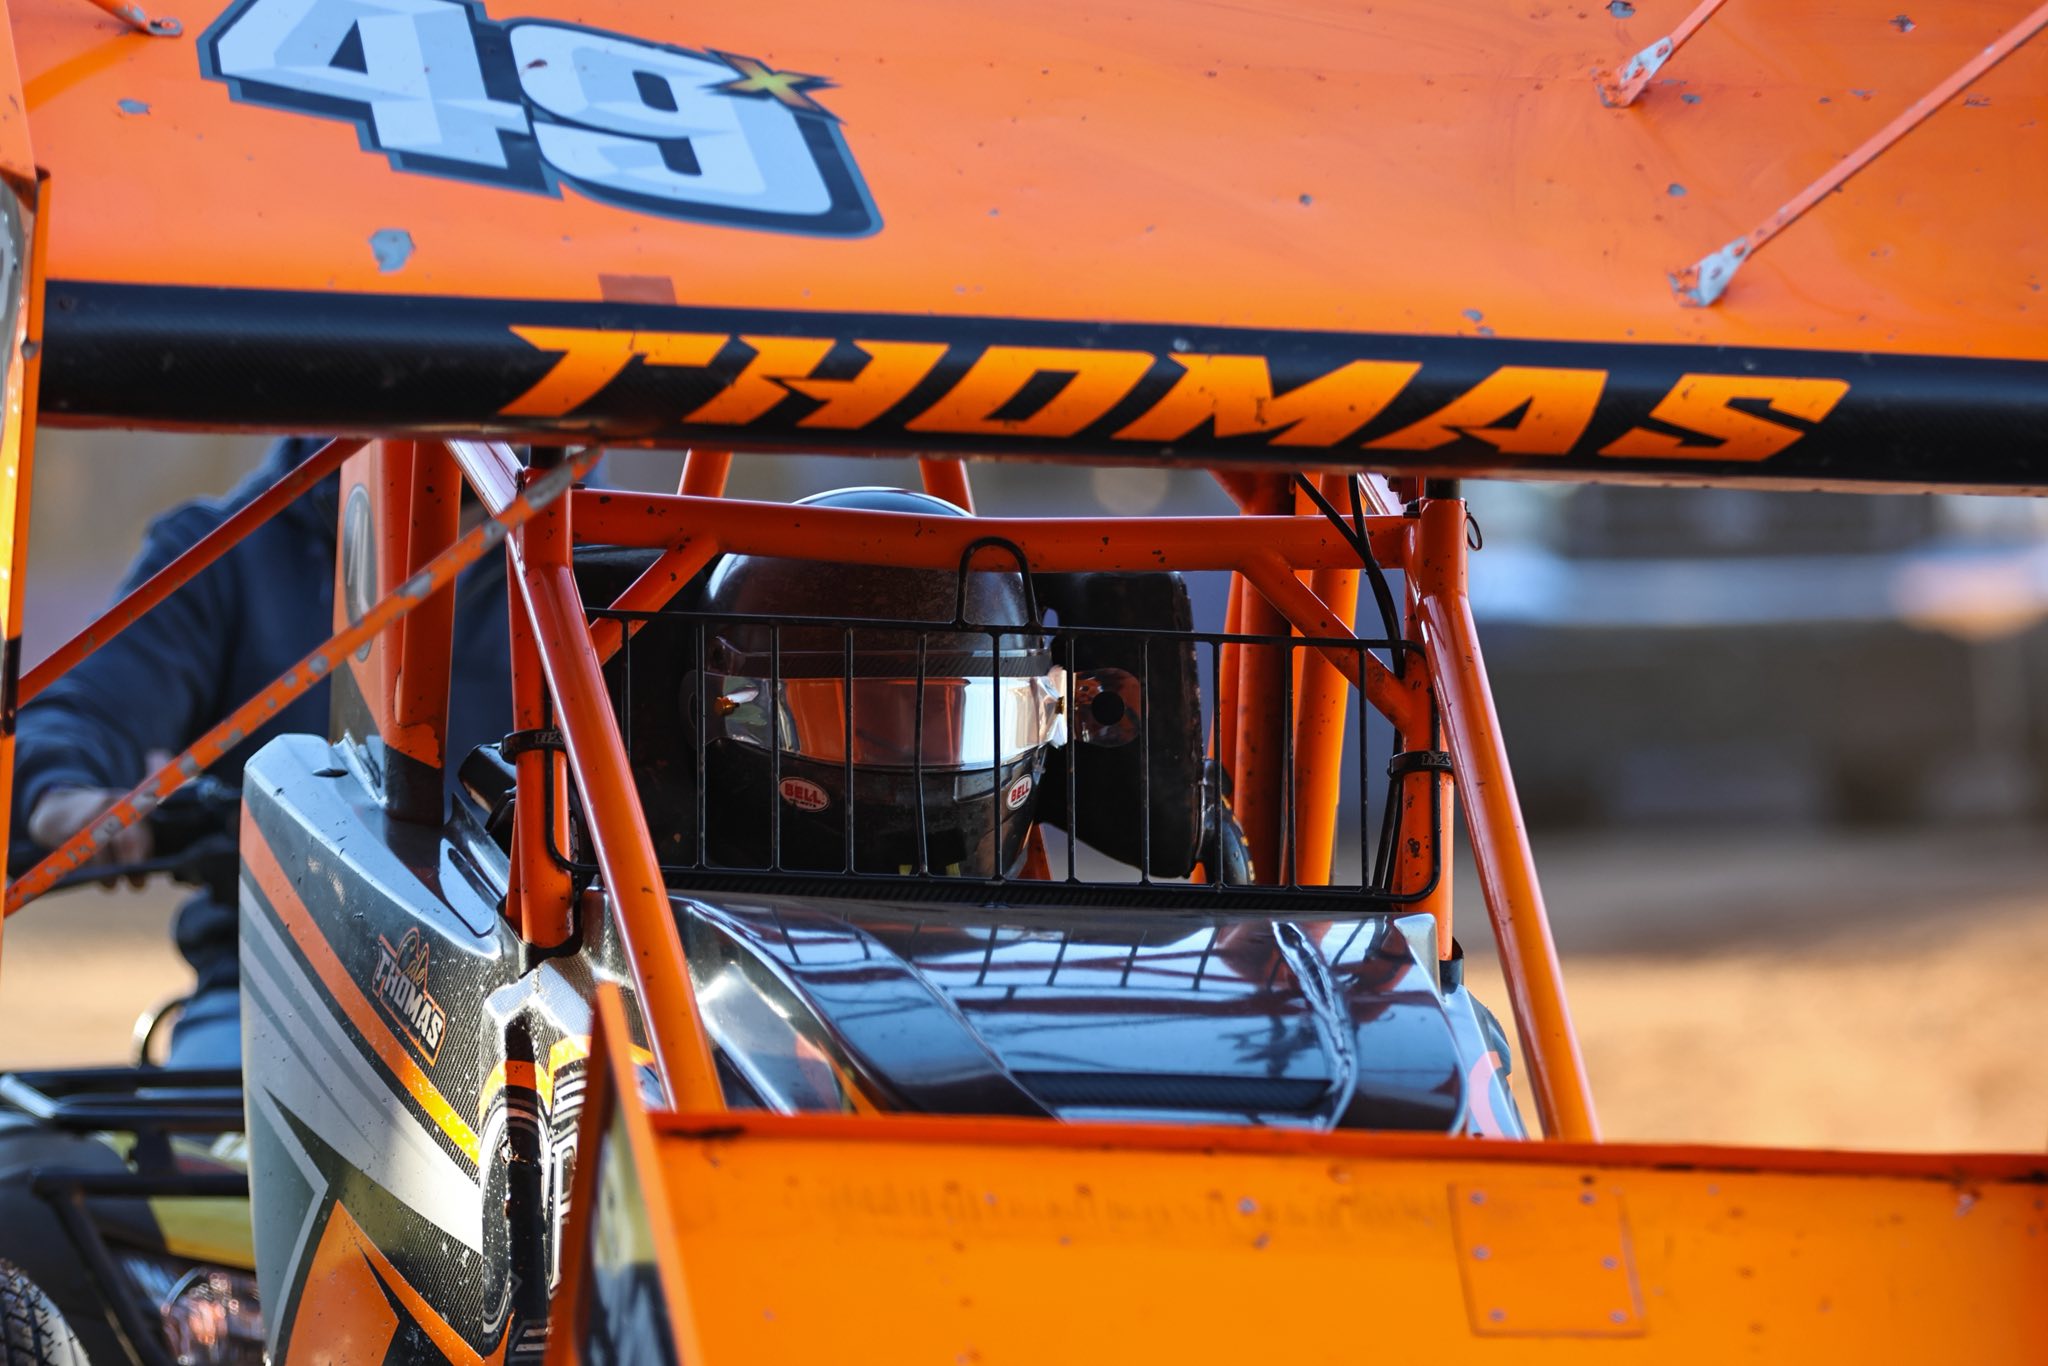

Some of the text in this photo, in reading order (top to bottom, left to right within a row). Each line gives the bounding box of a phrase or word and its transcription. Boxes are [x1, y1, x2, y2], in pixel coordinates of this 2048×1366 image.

[498, 325, 1851, 462] THOMAS
[784, 782, 822, 804] BELL
[1010, 781, 1030, 801] BELL
[375, 948, 443, 1049] THOMAS
